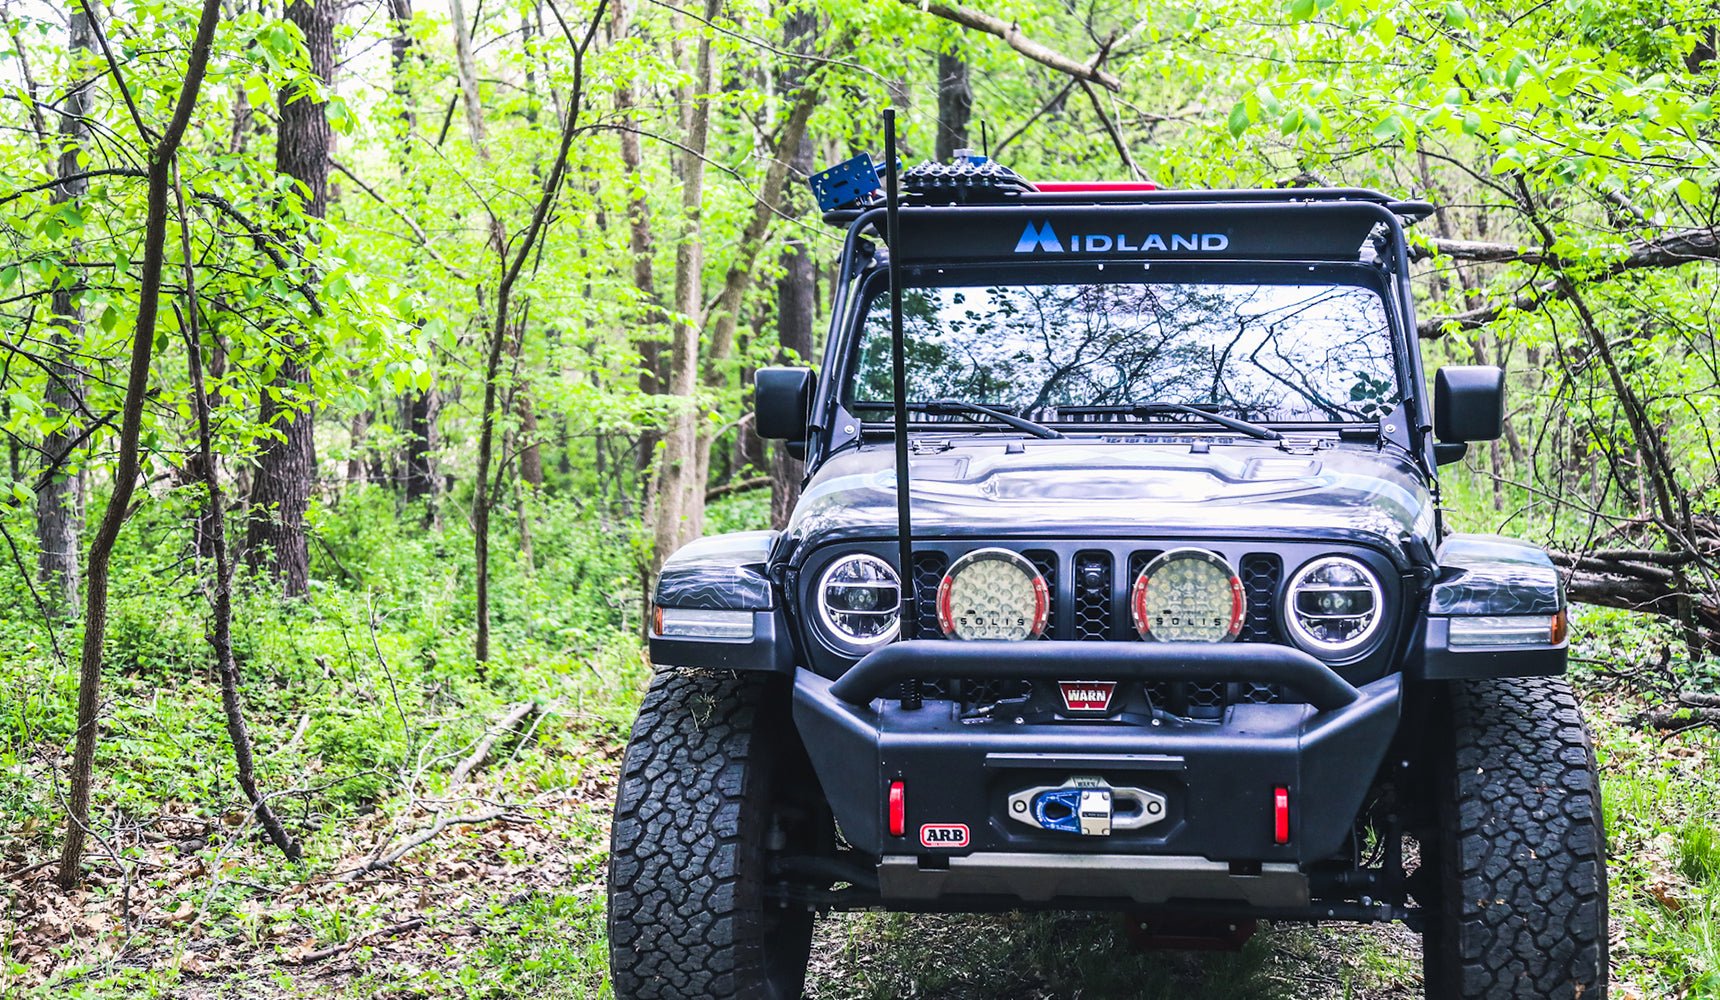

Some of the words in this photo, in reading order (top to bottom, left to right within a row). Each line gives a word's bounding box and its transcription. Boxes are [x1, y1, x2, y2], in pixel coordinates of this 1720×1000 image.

[1014, 219, 1229, 253] MIDLAND
[960, 617, 1025, 626] SOLIS
[1156, 617, 1221, 626] SOLIS
[1067, 689, 1106, 702] WARN
[927, 829, 964, 841] ARB
